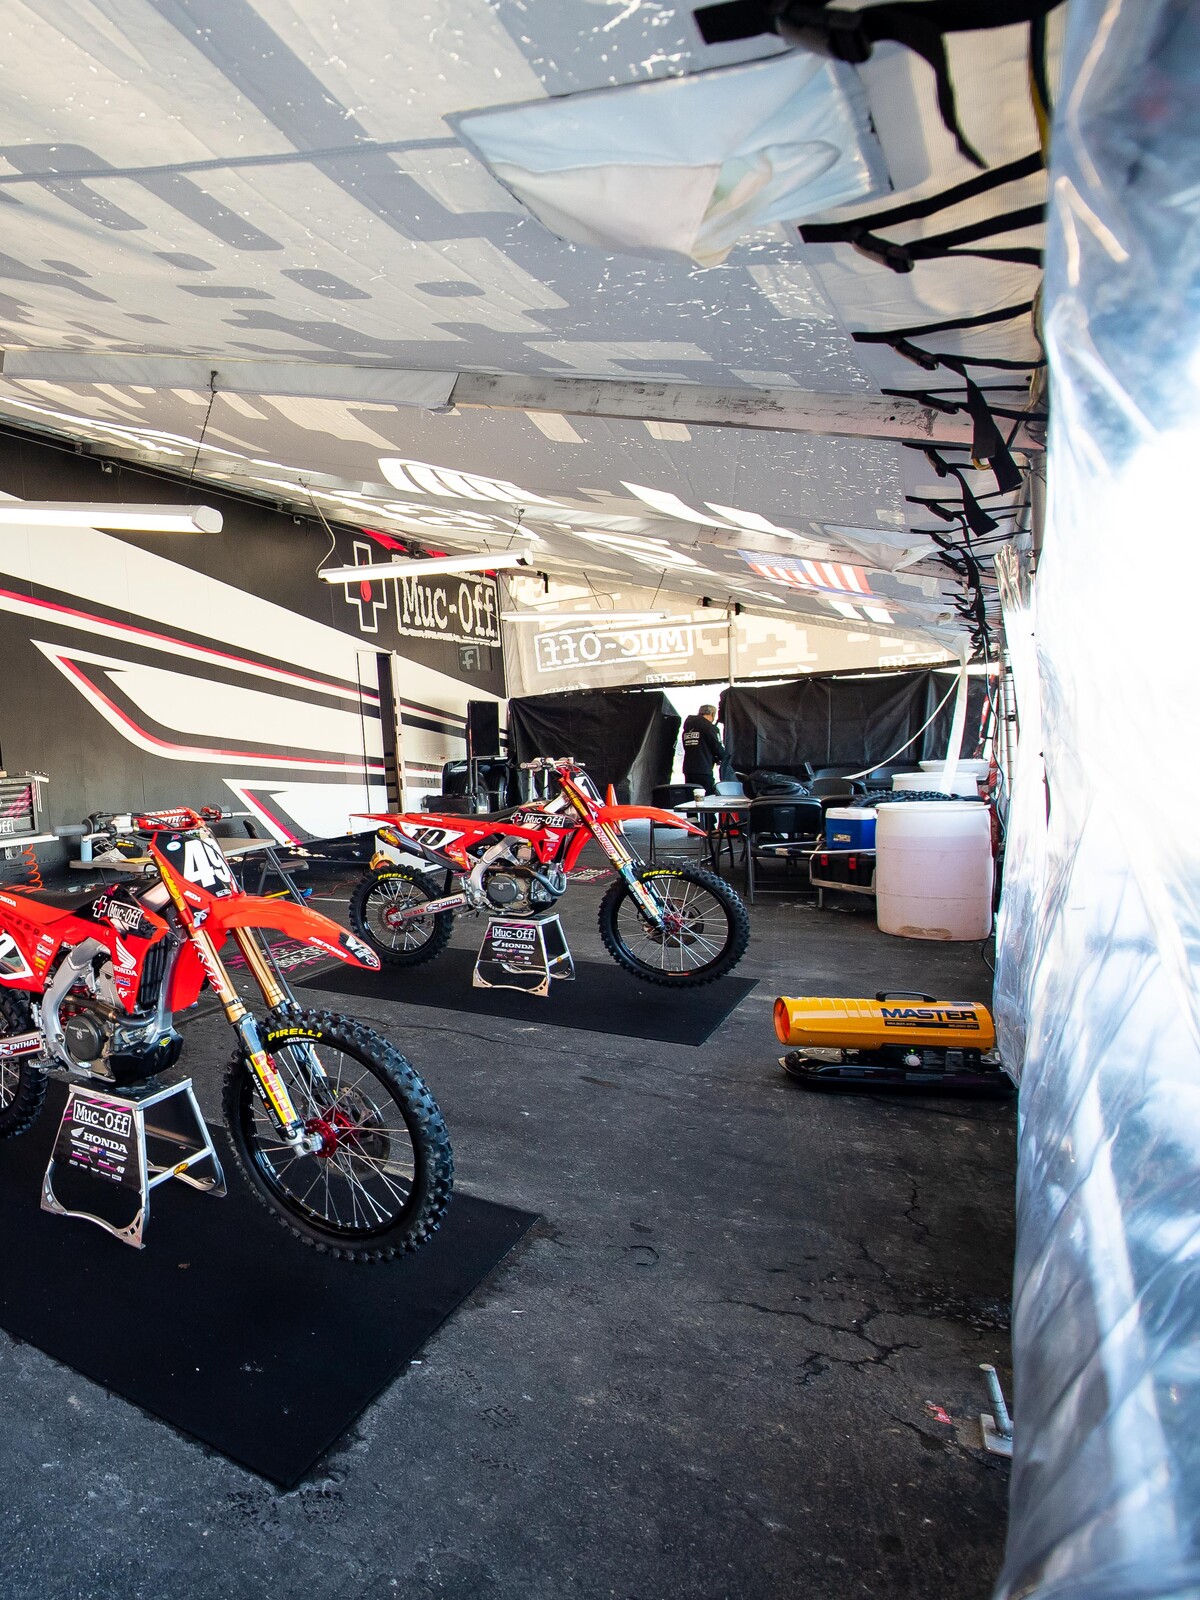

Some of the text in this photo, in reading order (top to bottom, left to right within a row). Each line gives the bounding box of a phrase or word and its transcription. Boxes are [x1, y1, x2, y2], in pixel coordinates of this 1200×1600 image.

[400, 576, 495, 638] Muc-Off
[421, 815, 443, 823] HONDA
[525, 815, 563, 827] Muc-Off
[411, 827, 447, 847] 10
[183, 837, 231, 888] 49
[378, 872, 413, 881] PIRELLI
[642, 869, 684, 878] PIRELLI
[426, 898, 463, 913] RENTHAL
[110, 903, 142, 927] Muc-Off
[494, 927, 534, 940] Muc-Off
[501, 942, 535, 950] HONDA
[113, 964, 138, 977] HONDA
[880, 1007, 979, 1022] MASTER
[267, 1028, 323, 1041] PIRELLI
[75, 1103, 129, 1134] Muc-Off
[83, 1131, 129, 1154] HONDA
